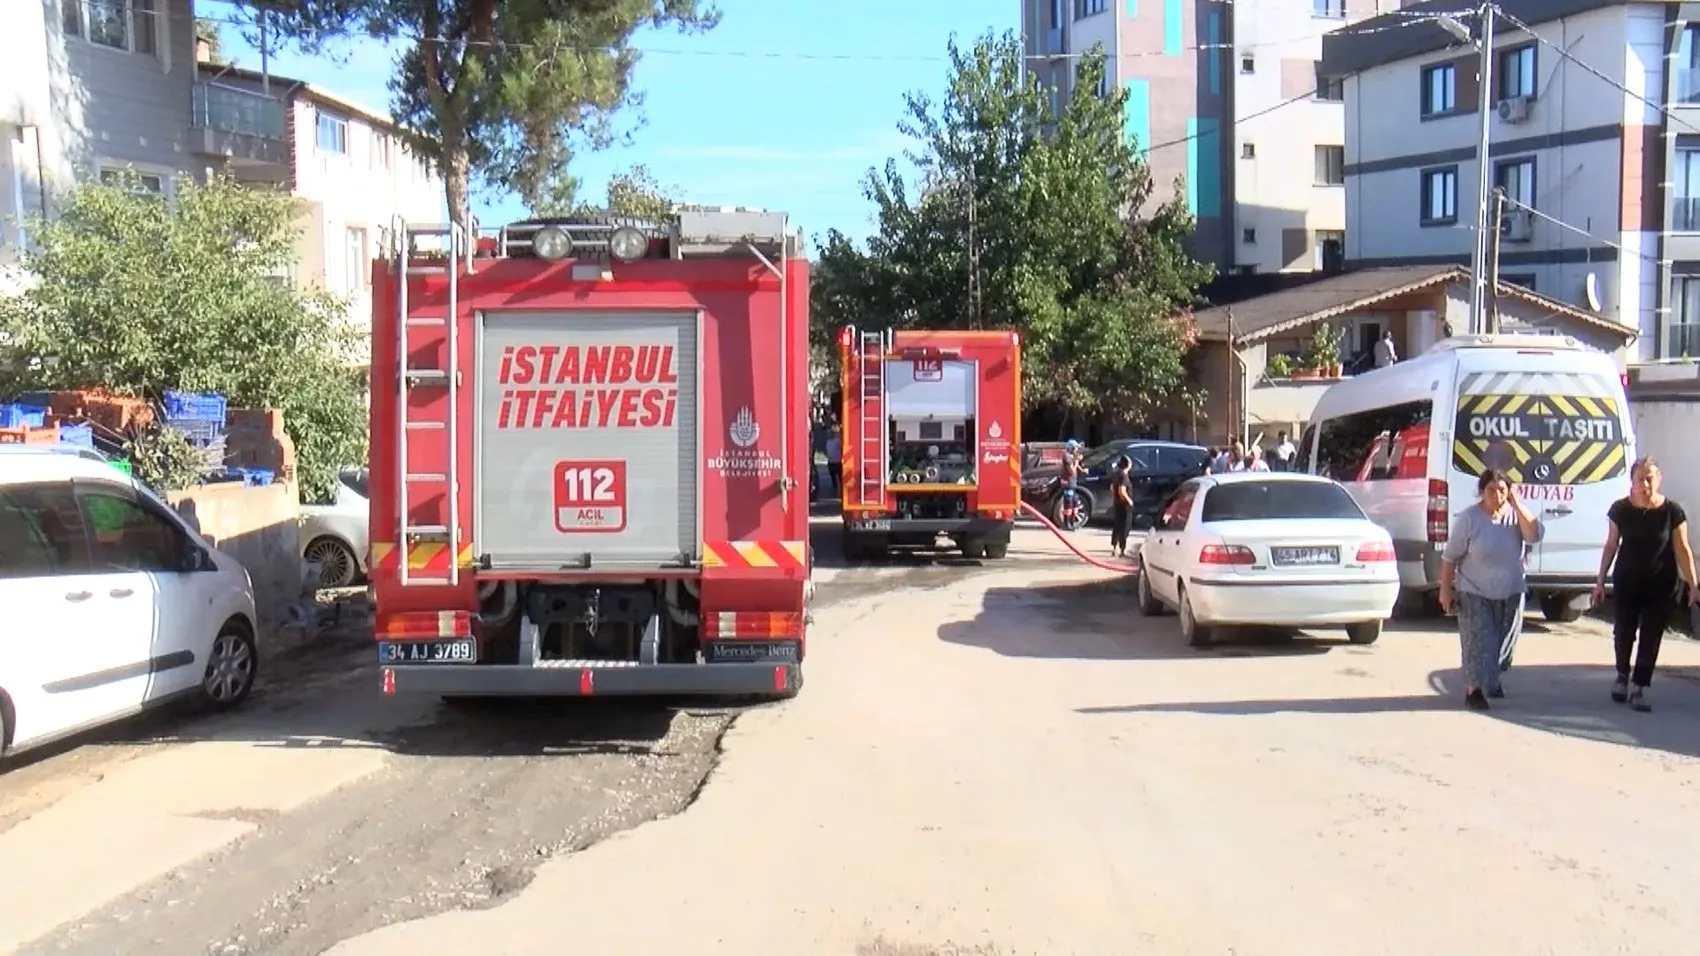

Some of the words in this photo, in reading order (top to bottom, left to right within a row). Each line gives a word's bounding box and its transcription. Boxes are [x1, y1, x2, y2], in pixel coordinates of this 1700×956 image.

[1469, 416, 1529, 437] OKUL
[1544, 418, 1613, 441] TAŞITI
[707, 456, 781, 469] BÜYÜKŞEHİR
[564, 467, 616, 502] 112
[388, 644, 405, 660] 34
[410, 643, 428, 659] AJ
[434, 643, 470, 659] 3789
[714, 645, 765, 657] Mercedes
[768, 644, 796, 657] Benz
